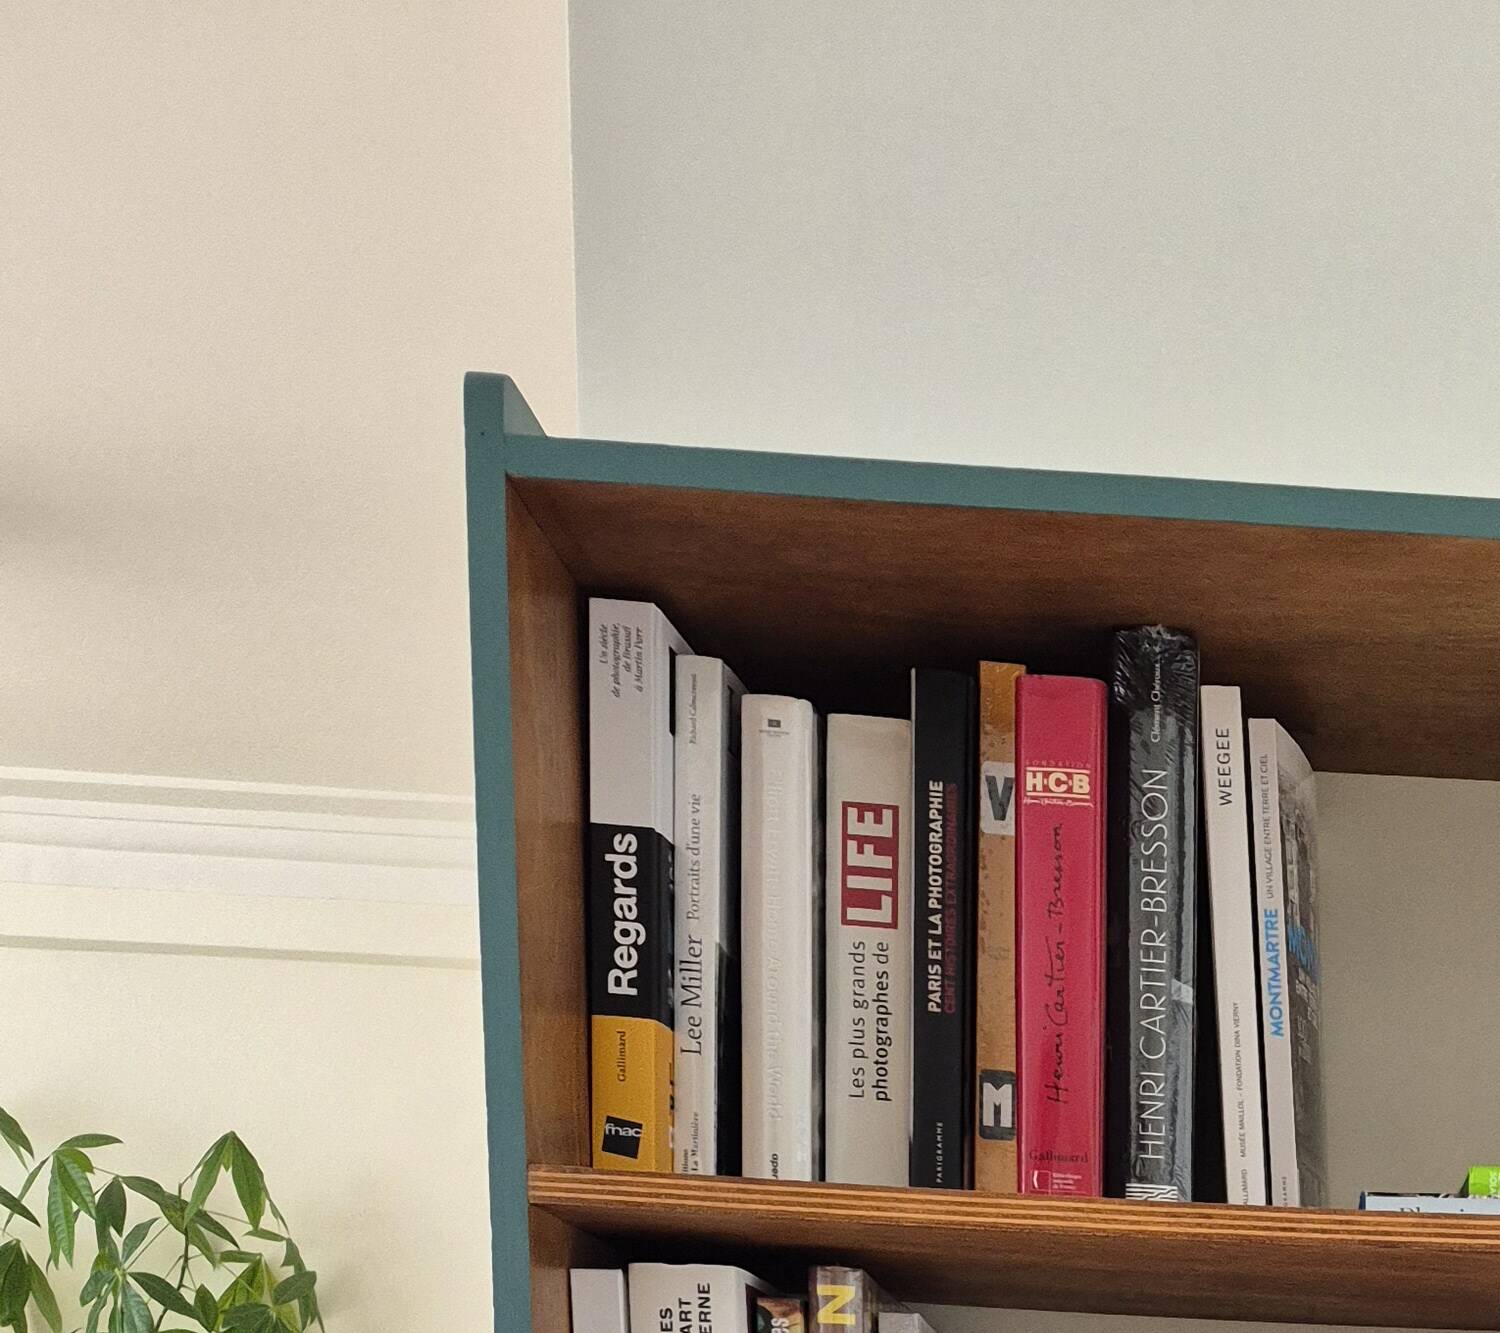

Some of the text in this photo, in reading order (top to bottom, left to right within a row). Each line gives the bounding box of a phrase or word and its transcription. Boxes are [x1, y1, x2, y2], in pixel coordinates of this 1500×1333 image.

[1214, 727, 1234, 806] WEEGEE
[603, 831, 646, 996] Regards
[677, 793, 703, 1056] Lee Miller Portraits d'une vie
[846, 806, 894, 924] LIFE
[927, 780, 943, 1014] PARIS ET LA PHOTOGRAPHIE
[944, 783, 957, 1015] CENT HISTOIRES EXTRAORDINAIRES
[1259, 753, 1285, 1038] MONTMARTRE UN VILLAGE ENTRE TERRE CIEL
[847, 940, 869, 1099] Les plus grands
[870, 941, 892, 1102] photographes de
[1138, 768, 1169, 1162] HENRI CARTIER-BRESSON
[603, 1123, 642, 1138] fnac
[616, 1031, 628, 1082] Gallimard
[982, 1082, 1013, 1128] M
[935, 1120, 944, 1185] PARIGRAMME
[1028, 1148, 1089, 1164] Gallimard
